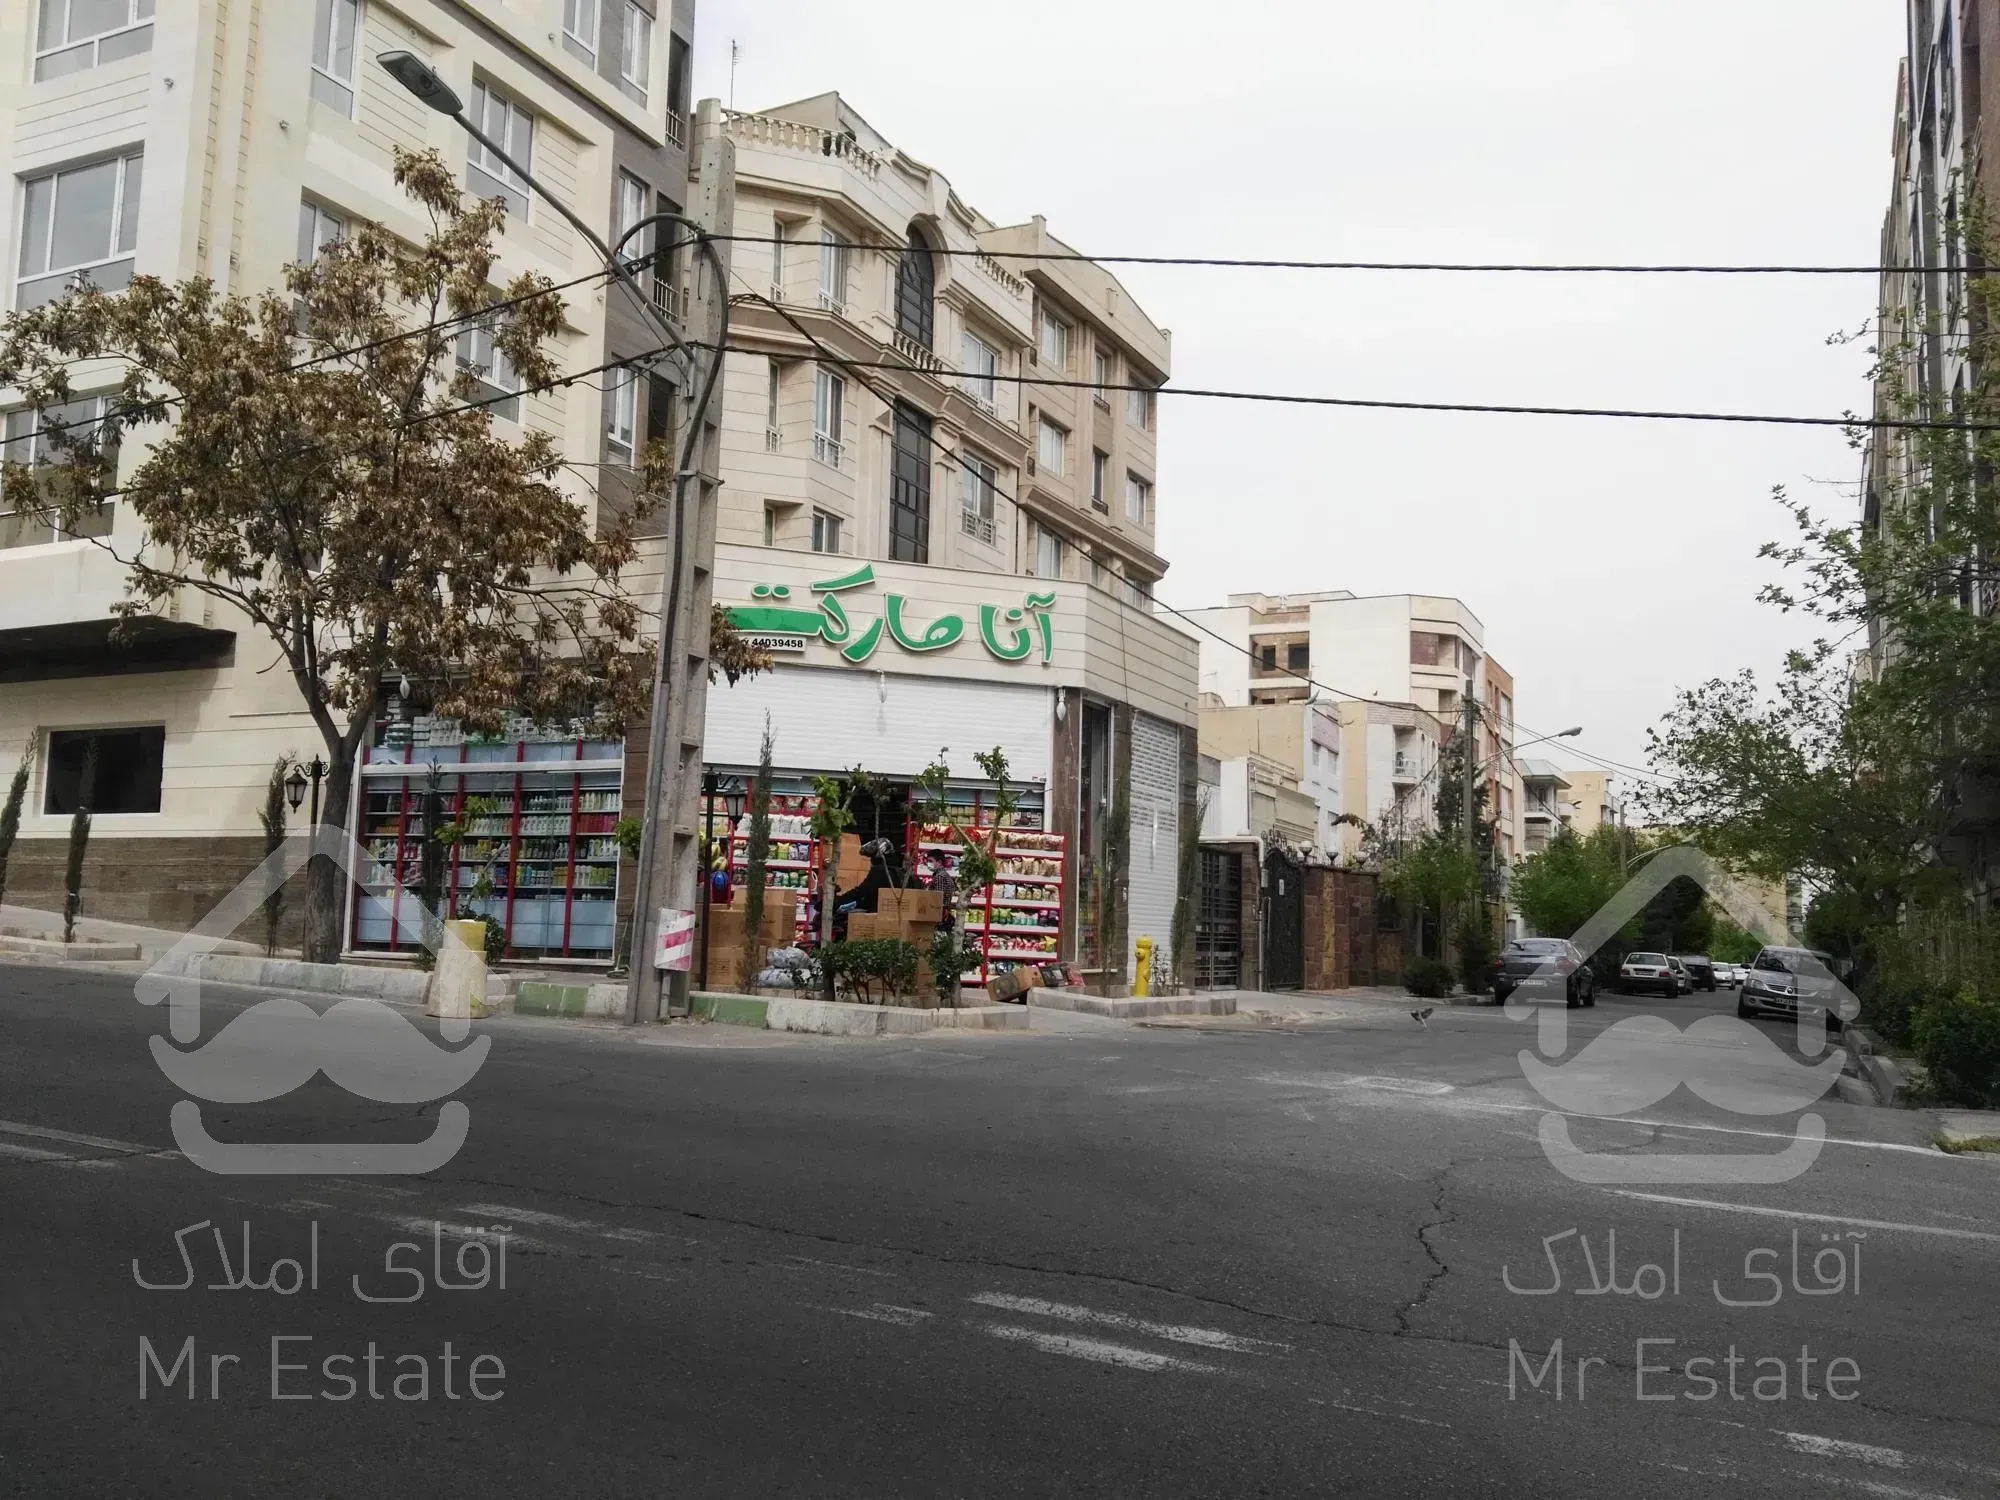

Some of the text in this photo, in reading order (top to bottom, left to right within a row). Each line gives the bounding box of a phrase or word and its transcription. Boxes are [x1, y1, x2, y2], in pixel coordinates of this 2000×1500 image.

[729, 561, 1056, 664] آنا مارکت
[751, 638, 804, 648] 44039458
